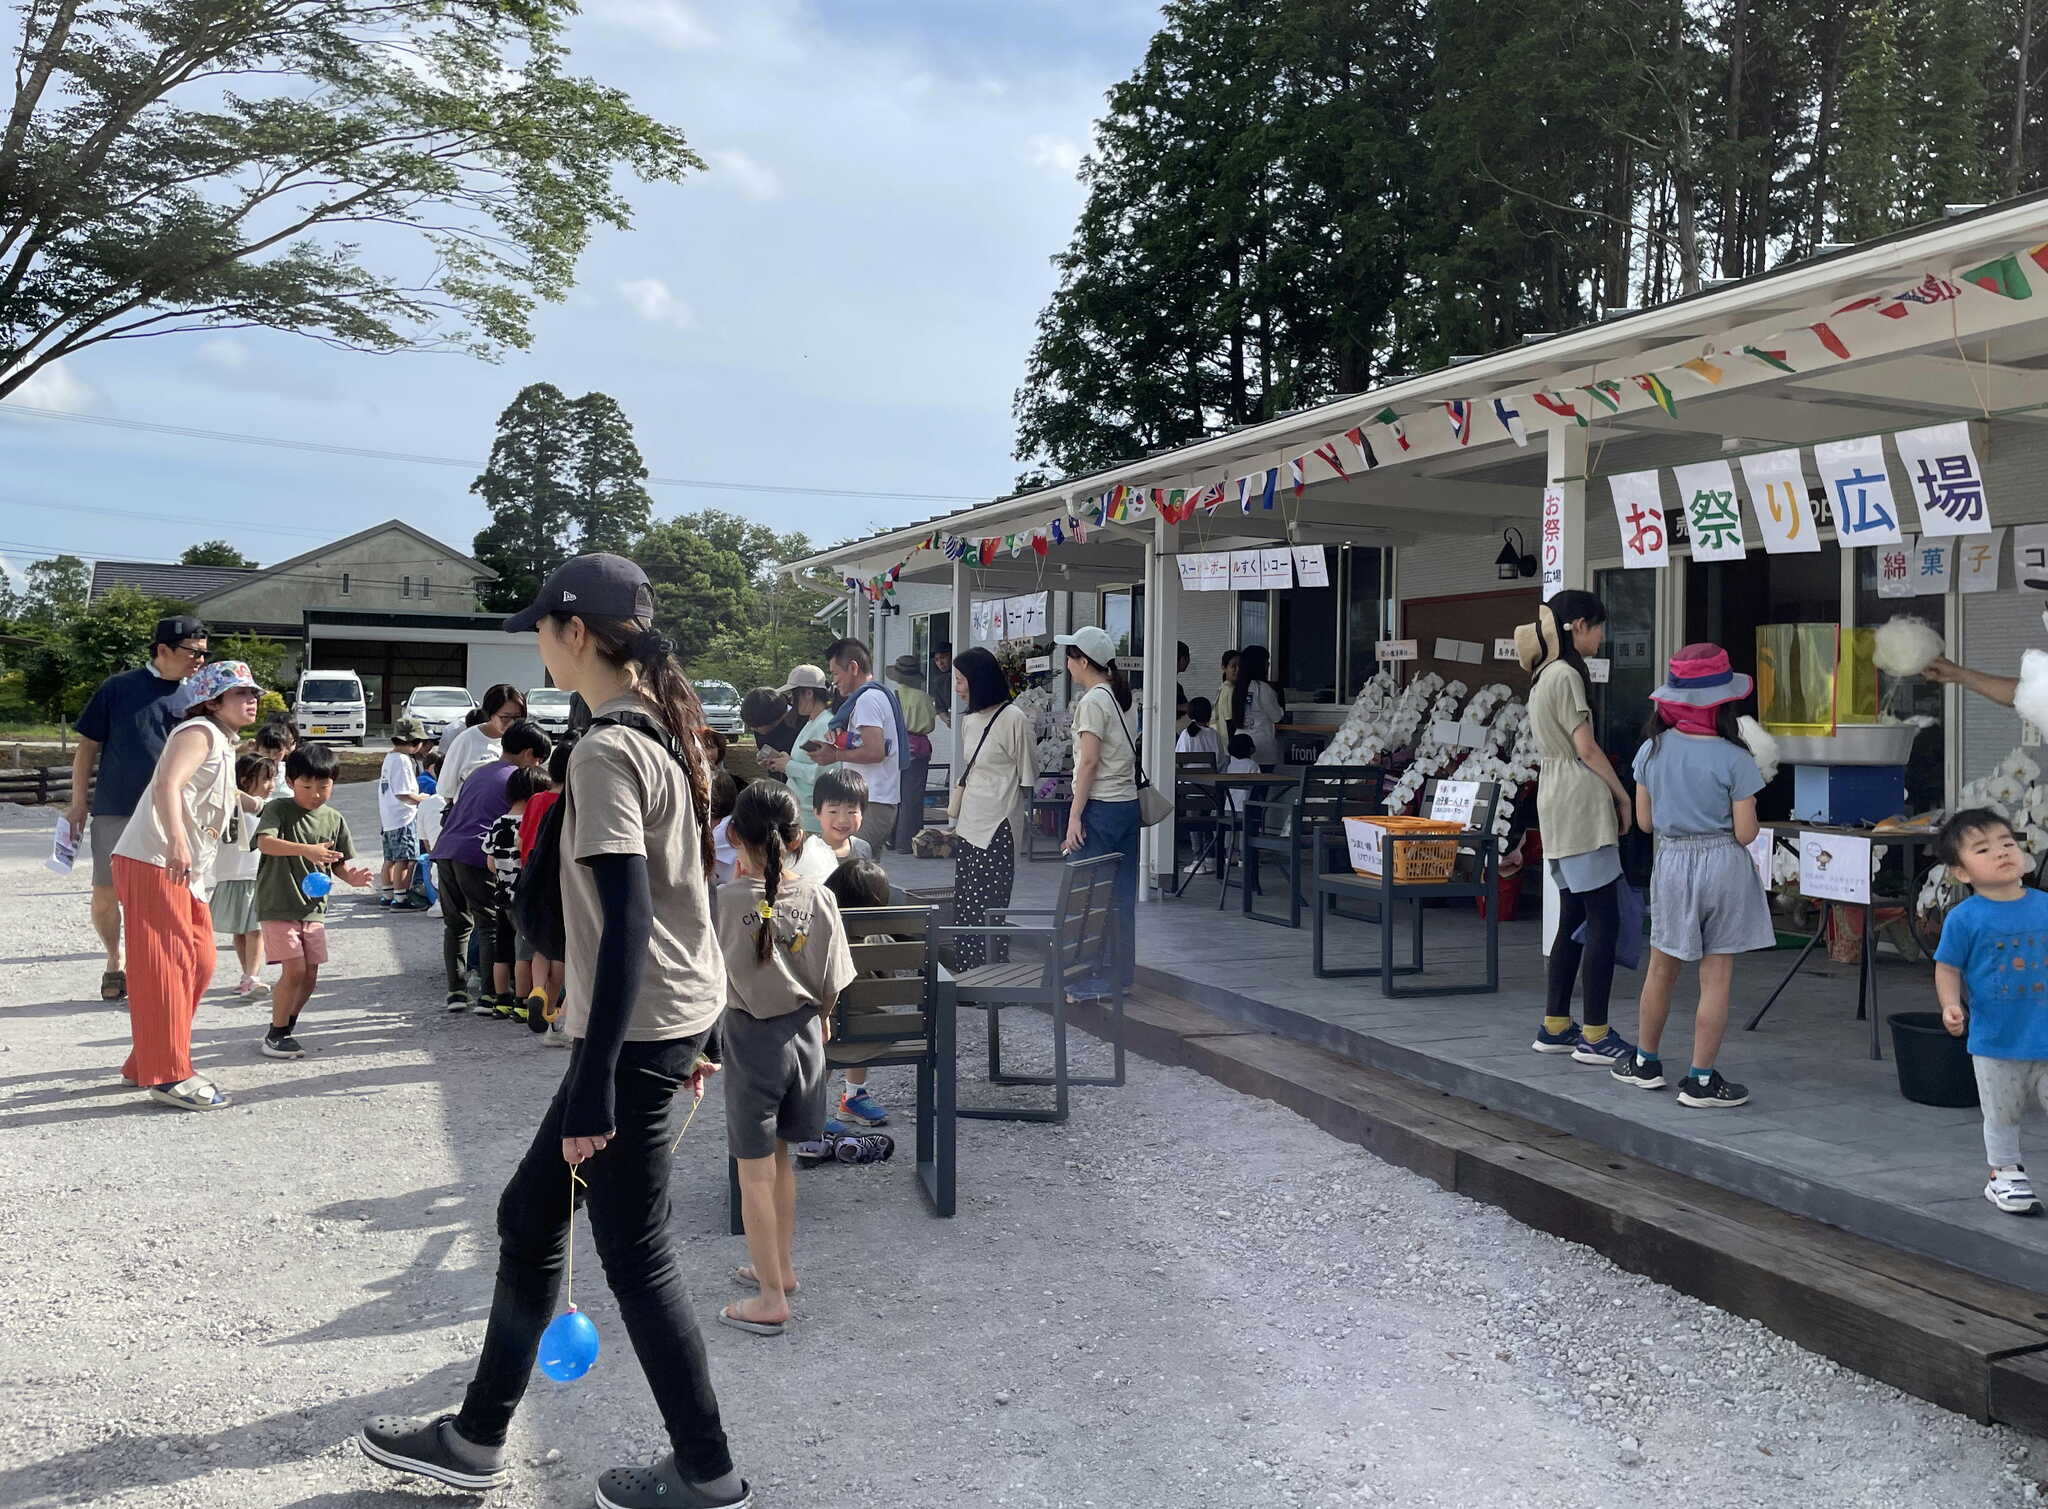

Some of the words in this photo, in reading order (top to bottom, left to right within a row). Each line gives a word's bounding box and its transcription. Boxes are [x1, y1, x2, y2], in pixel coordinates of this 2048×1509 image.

[1625, 454, 1983, 556] お祭り広場
[1180, 556, 1318, 575] スーーボールすくいコーナー
[1291, 743, 1317, 761] front
[742, 906, 784, 926] CHL
[791, 908, 815, 924] OUT
